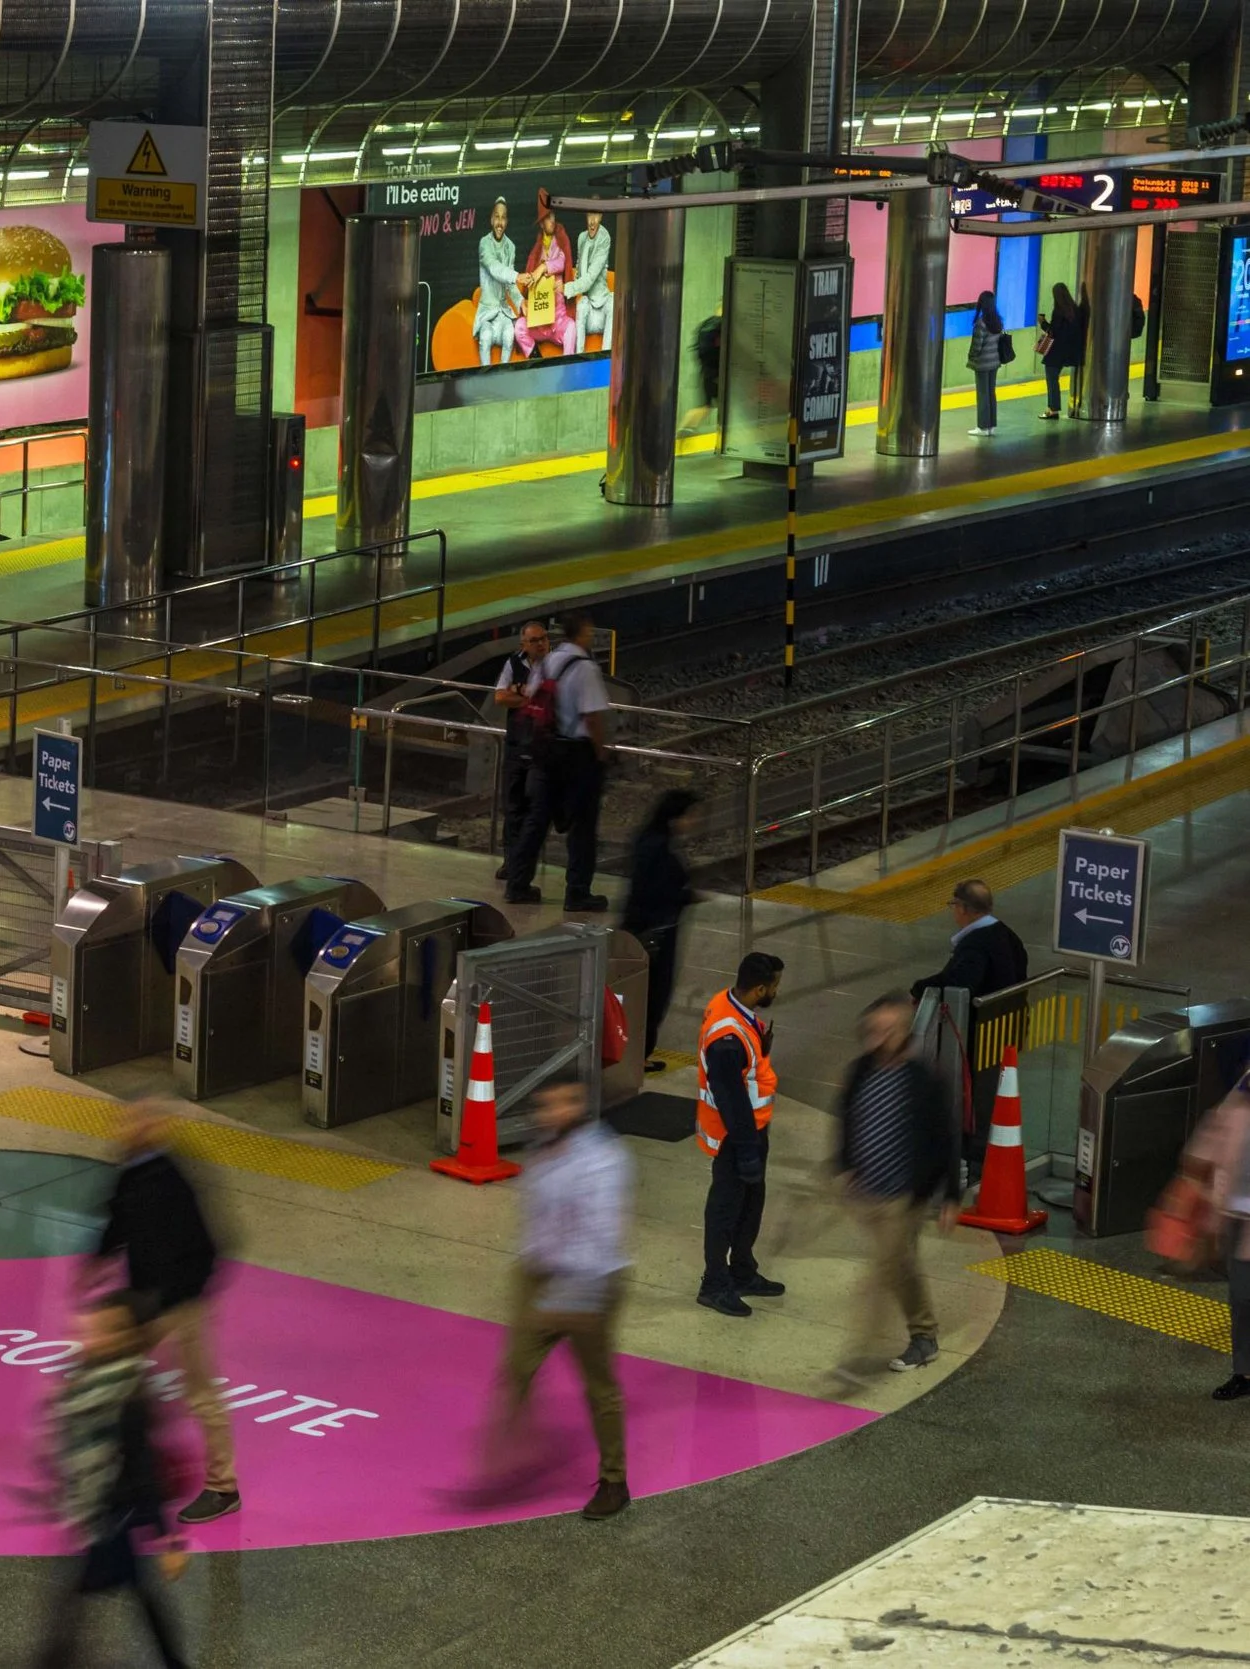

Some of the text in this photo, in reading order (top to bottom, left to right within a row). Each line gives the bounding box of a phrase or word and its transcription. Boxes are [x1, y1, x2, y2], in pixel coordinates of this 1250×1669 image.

[122, 183, 171, 201] Warning
[386, 182, 460, 205] I'll be eating
[1091, 174, 1114, 212] 2
[443, 210, 452, 233] &
[455, 208, 476, 231] JEN
[813, 269, 839, 297] TRAIN
[533, 301, 549, 312] Eats
[534, 290, 549, 302] Uber
[809, 332, 838, 361] SWEAT
[803, 393, 840, 423] COMMIT
[41, 750, 71, 773] Paper
[38, 772, 77, 795] Tickets
[1075, 856, 1130, 881] Paper
[1068, 880, 1132, 907] Tickets
